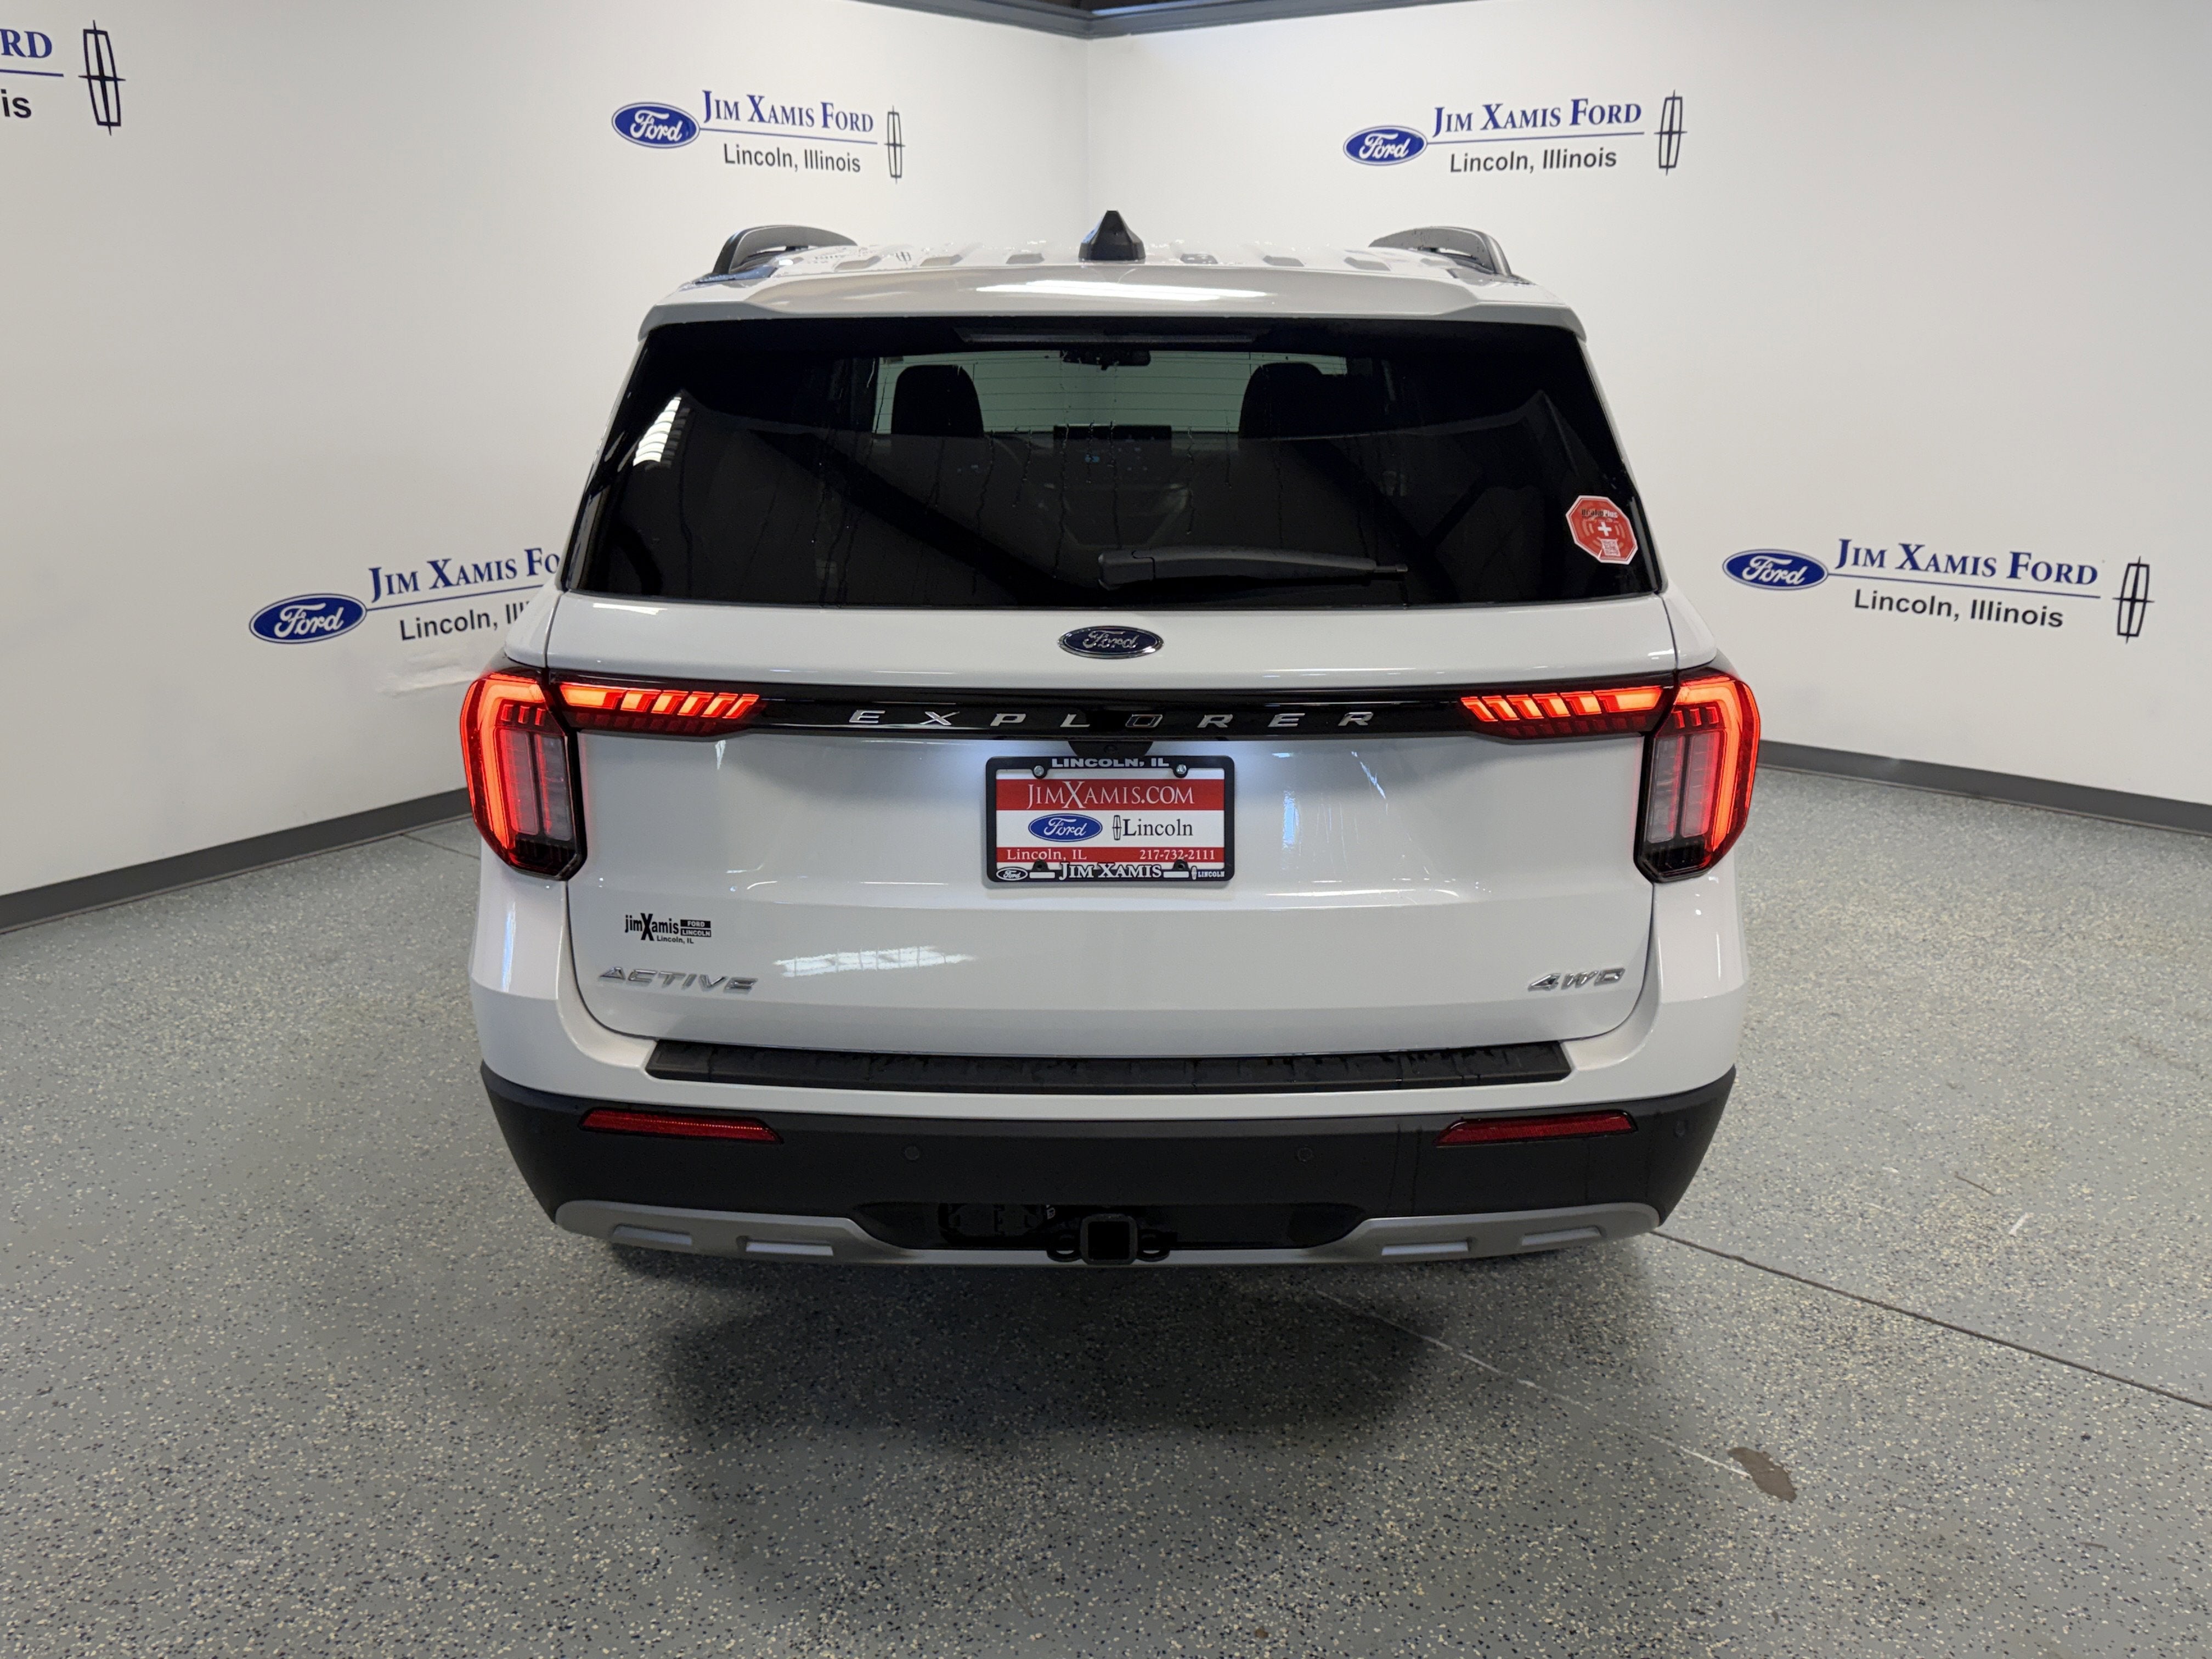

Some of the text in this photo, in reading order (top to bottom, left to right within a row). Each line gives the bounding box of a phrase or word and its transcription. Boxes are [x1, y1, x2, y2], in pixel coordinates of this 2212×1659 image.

[702, 90, 874, 132] JIM XAMIS FORD
[1432, 98, 1642, 138] JIM XAMIS FORD
[630, 110, 683, 142] Ford
[724, 143, 861, 172] Lincoln, Illinois
[1358, 133, 1409, 159] Ford
[1450, 148, 1617, 173] Lincoln, Illinois
[1741, 555, 1808, 585] Ford
[1835, 538, 2098, 585] JIM XAMIS FORD
[369, 567, 419, 603] JIM
[427, 558, 518, 590] XAMIS
[274, 603, 345, 637] Ford
[1854, 589, 2064, 628] Lincoln, Illinois
[399, 609, 498, 641] Lincoln,
[1082, 630, 1140, 648] Ford
[849, 709, 1374, 729] EXPLORER
[1051, 758, 1169, 768] LINCOLN, IL
[1026, 781, 1195, 809] JIMXAMIS.COM
[1043, 817, 1087, 838] Ford
[1122, 818, 1193, 837] Lincoln
[1007, 849, 1087, 861] Lincoln, IL
[1139, 849, 1215, 860] 217-732-2111
[1059, 862, 1163, 881] JIM XAMIS
[657, 935, 685, 944] Lincoln,
[599, 966, 758, 991] ACTIVE
[1528, 967, 1626, 991] 4WD
